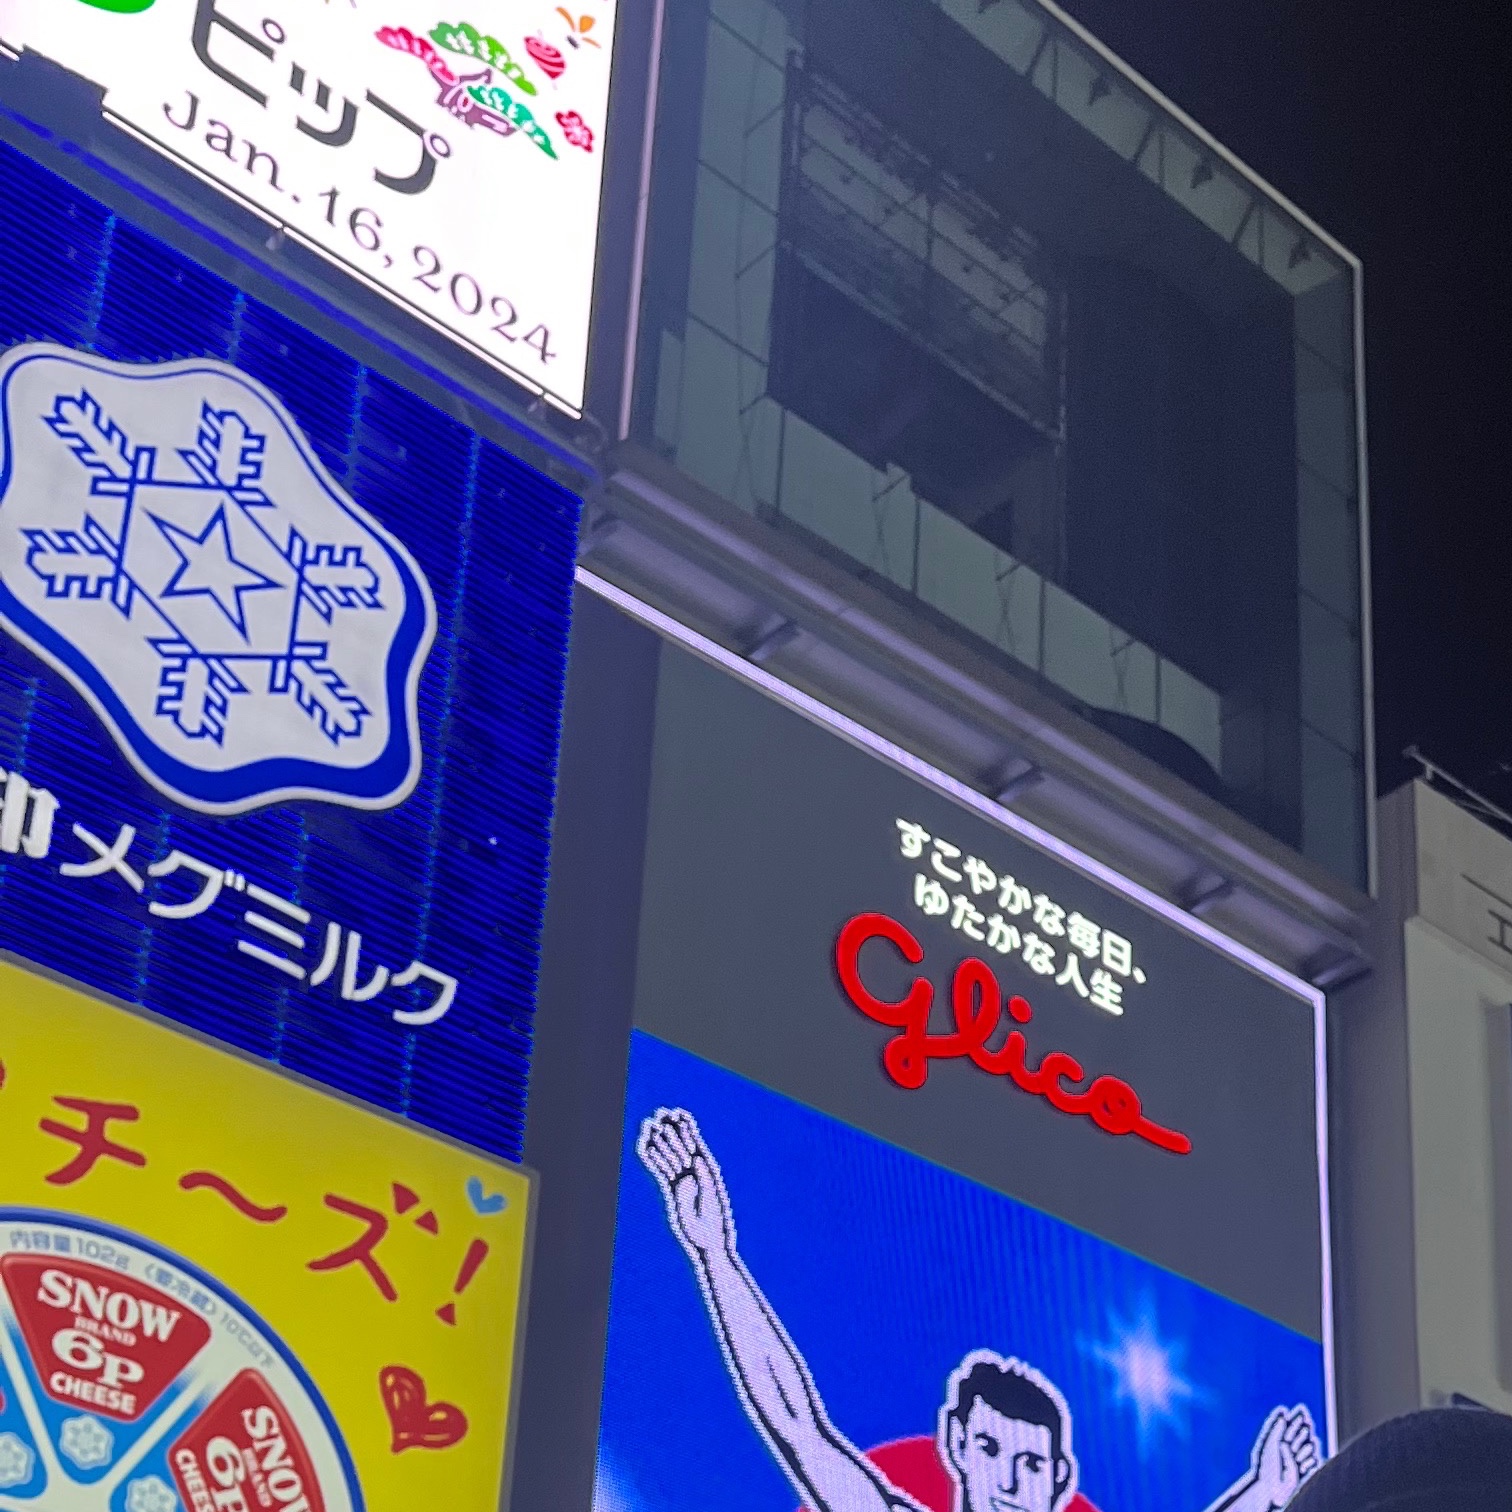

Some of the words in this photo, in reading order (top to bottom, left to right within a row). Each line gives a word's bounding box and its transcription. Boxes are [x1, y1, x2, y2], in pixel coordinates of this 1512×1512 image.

[192, 0, 454, 195] ピップ
[896, 818, 1147, 985] すこやかな毎日、
[914, 873, 1124, 1016] ゆたかな人生
[37, 1268, 182, 1343] SNOW
[51, 1327, 145, 1389] 6P
[49, 1370, 137, 1416] CHEESE
